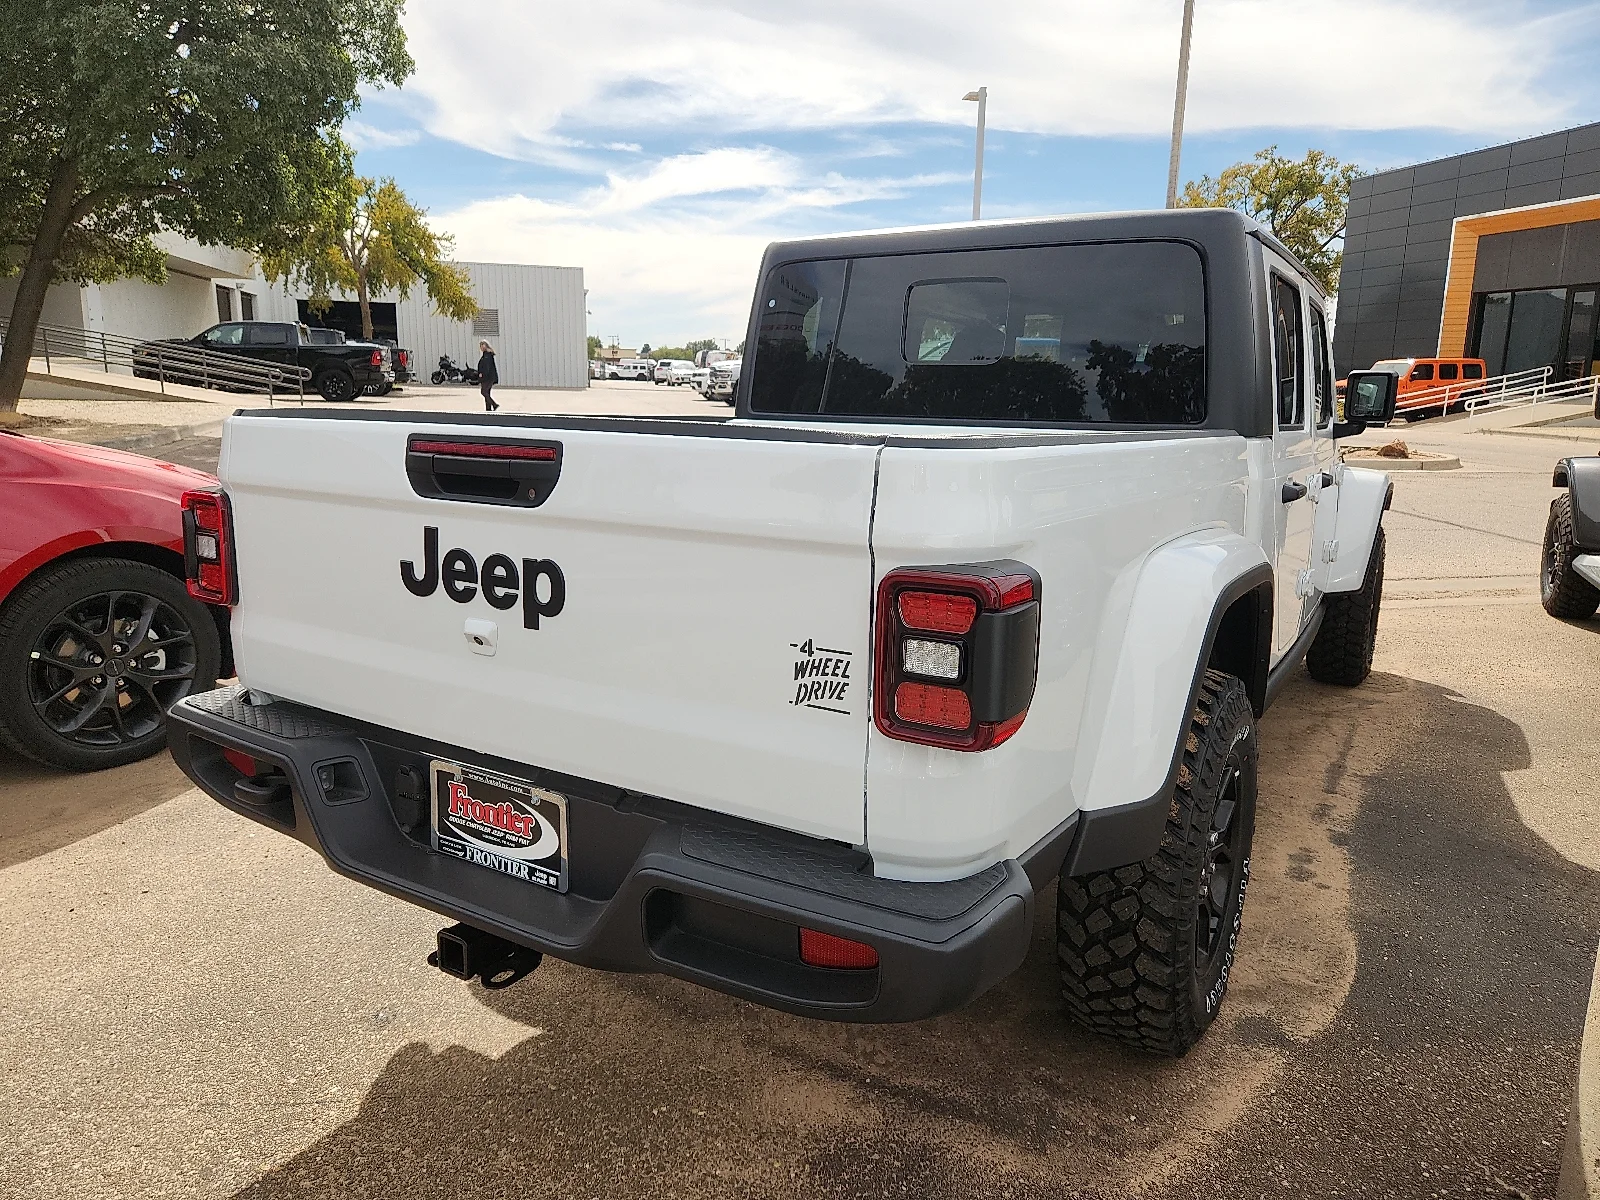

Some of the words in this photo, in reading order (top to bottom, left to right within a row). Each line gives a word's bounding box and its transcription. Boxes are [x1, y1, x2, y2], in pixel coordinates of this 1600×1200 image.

[400, 525, 566, 631] Jeep
[799, 638, 815, 658] 4
[794, 657, 851, 681] WHEEL
[794, 680, 850, 706] DRIVE
[448, 780, 536, 839] Frontier
[465, 846, 530, 881] FRONTIER
